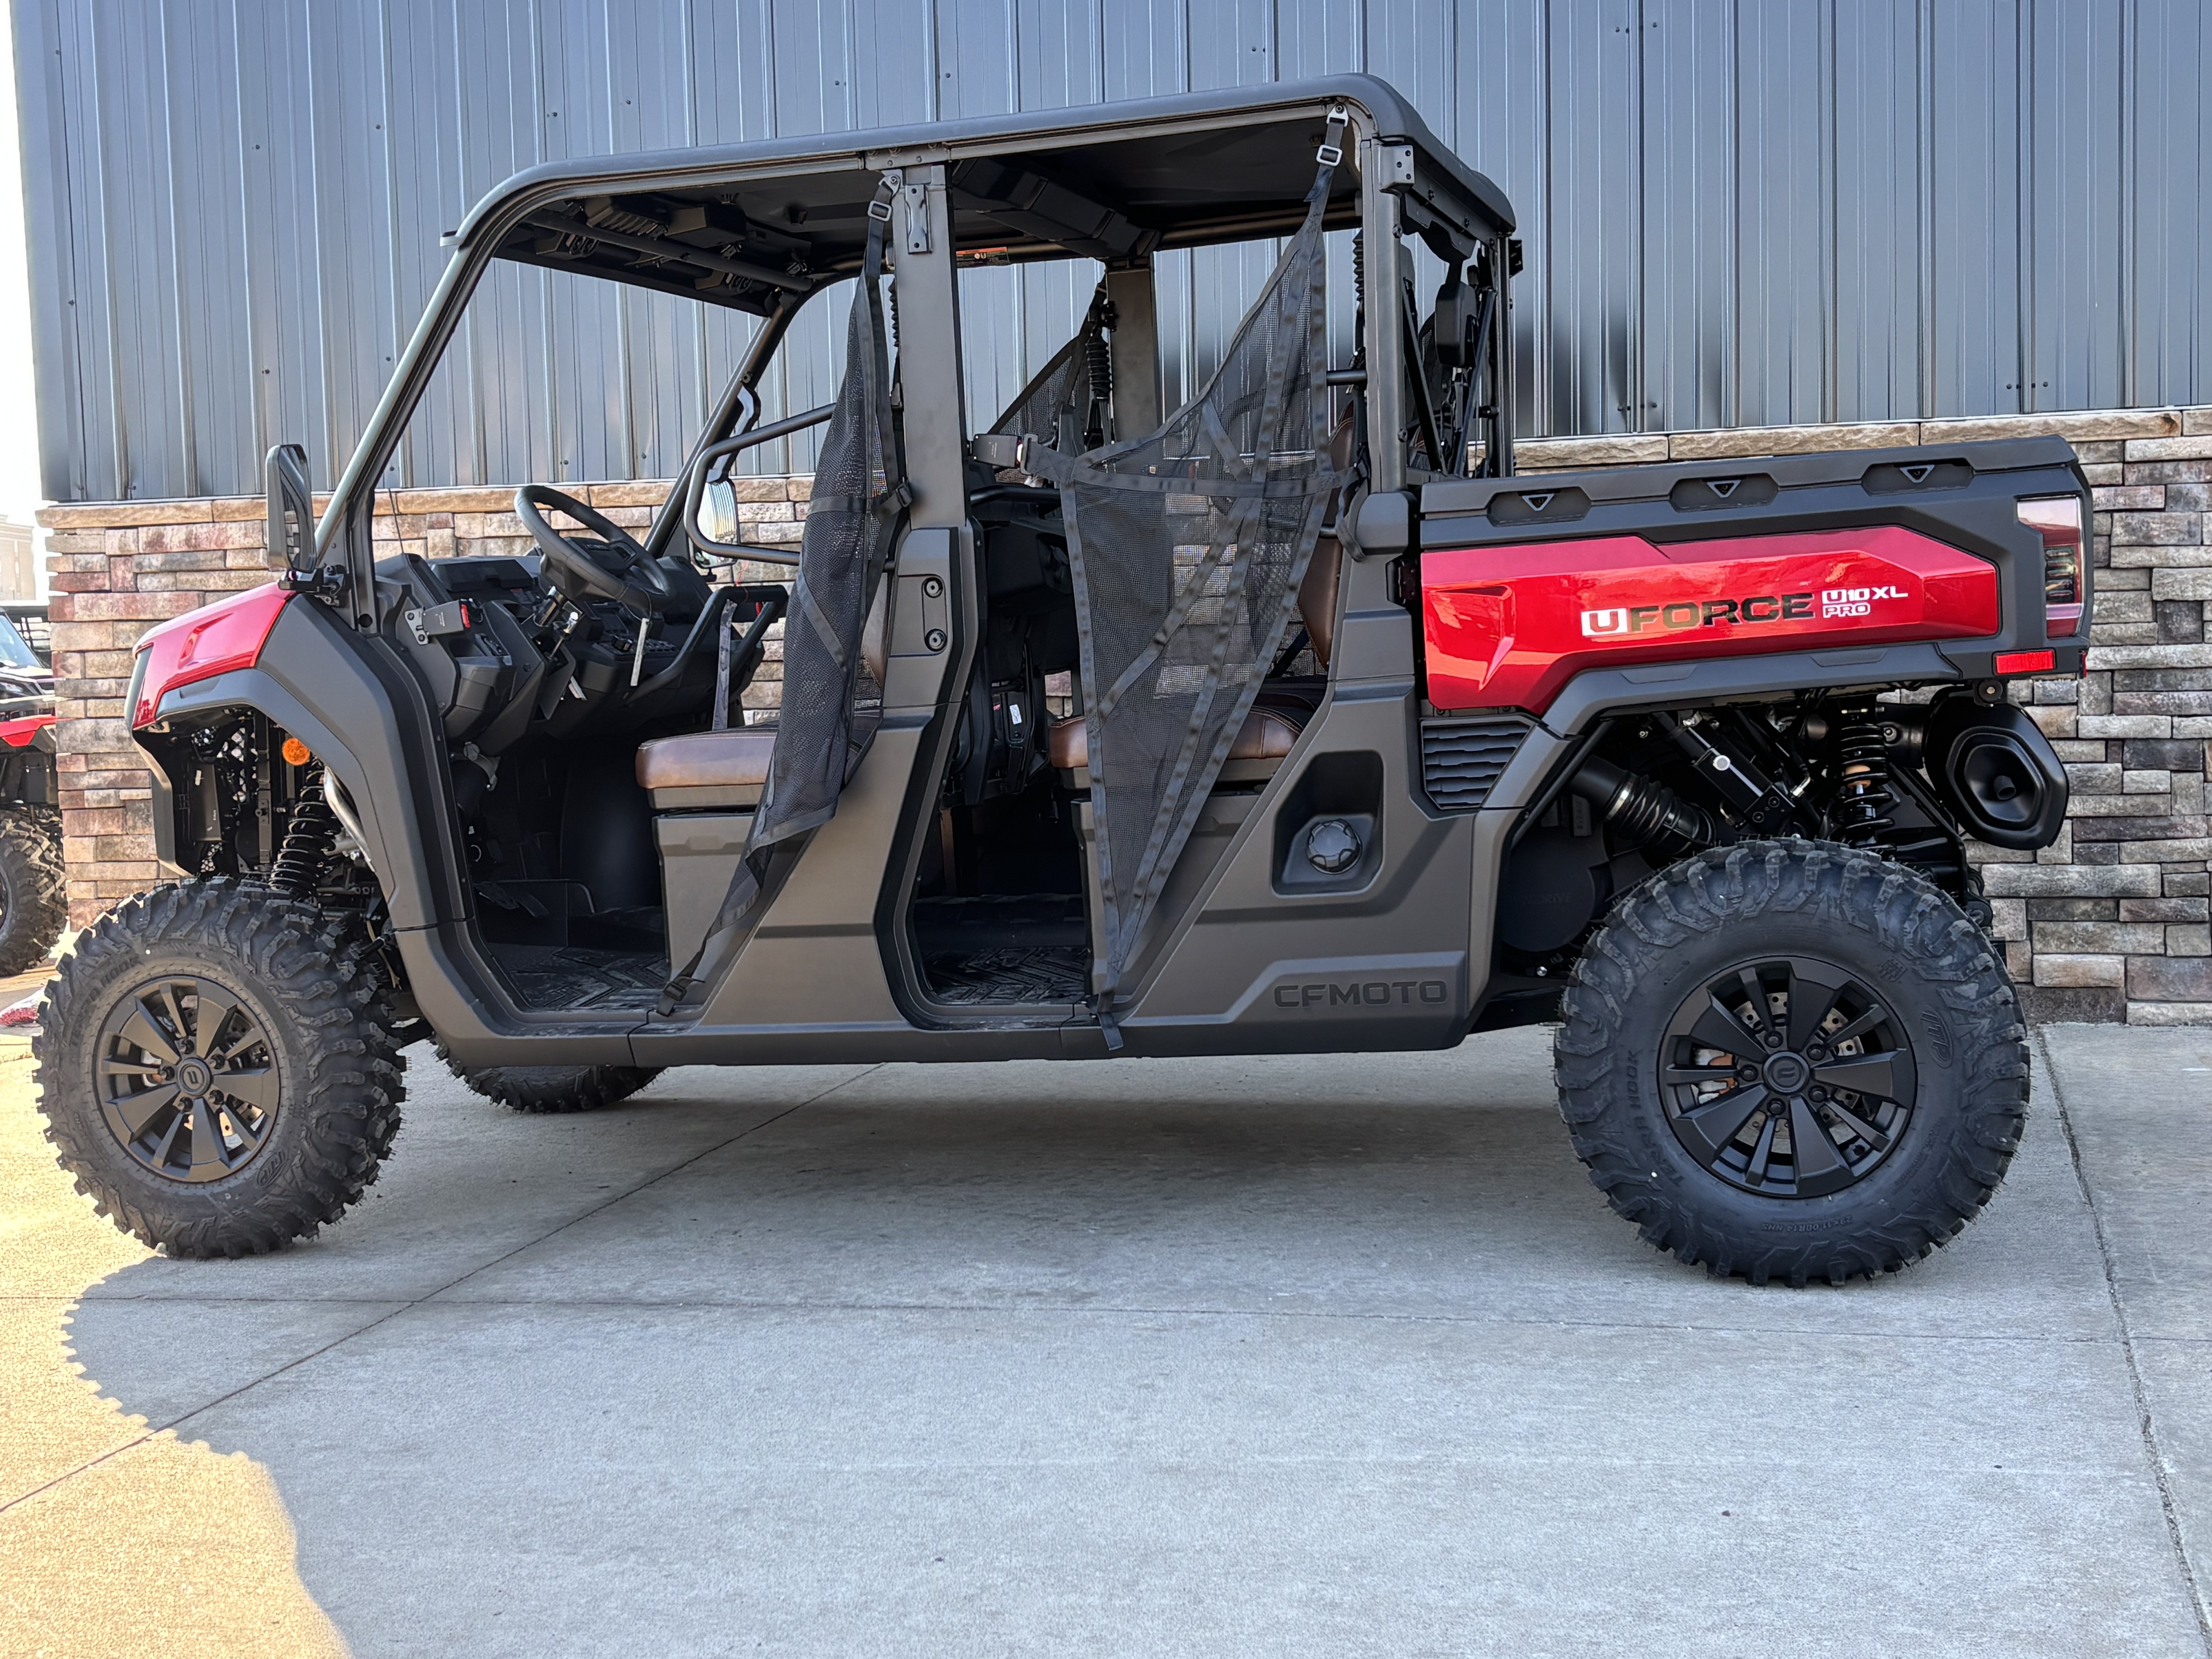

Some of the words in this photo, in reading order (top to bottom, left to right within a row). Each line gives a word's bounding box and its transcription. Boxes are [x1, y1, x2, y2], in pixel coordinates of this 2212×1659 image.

[1823, 602, 1870, 618] PRO
[1274, 981, 1447, 1007] CFMOTO
[1921, 1010, 1952, 1062] ITP
[1627, 1050, 1642, 1110] HOOK
[260, 1150, 286, 1186] ITP
